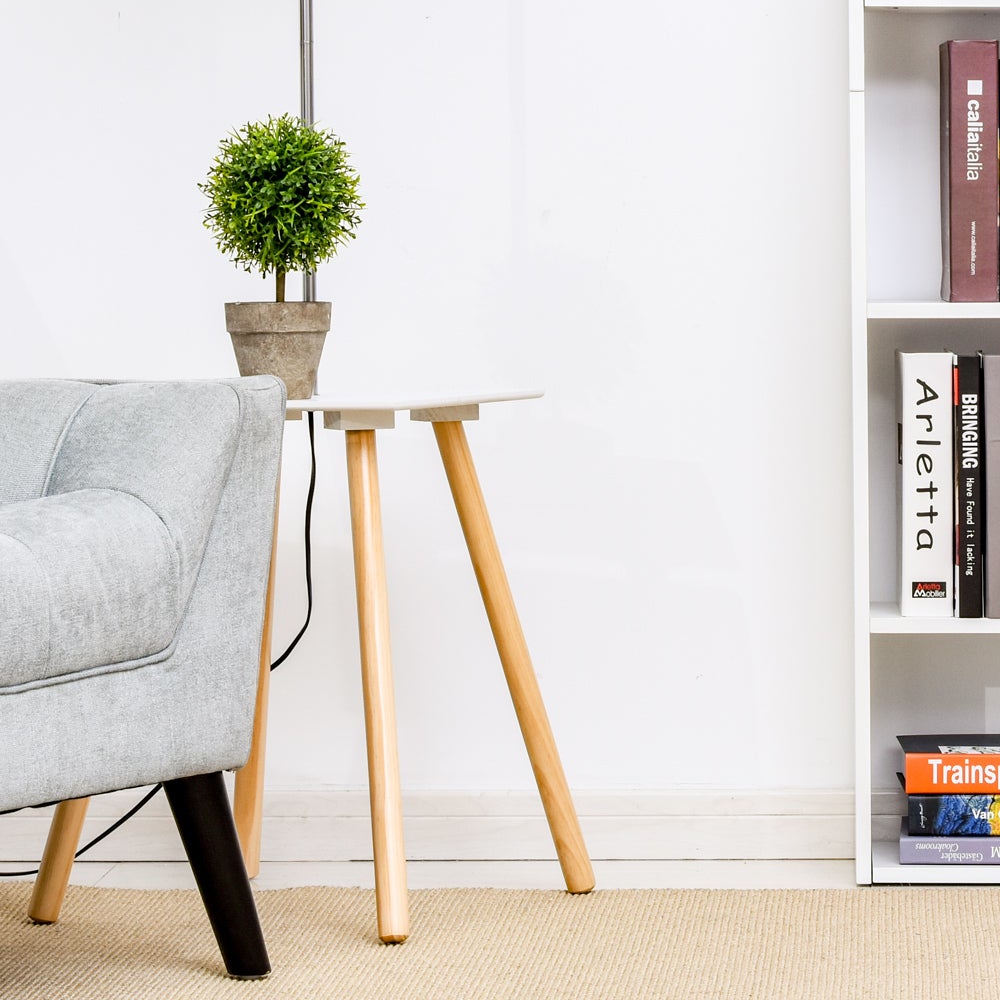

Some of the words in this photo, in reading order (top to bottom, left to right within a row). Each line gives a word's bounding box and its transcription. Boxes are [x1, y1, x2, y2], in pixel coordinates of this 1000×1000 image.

[966, 99, 984, 181] caliaitalia
[961, 393, 978, 469] BRINGING
[915, 378, 942, 551] Arletta
[966, 477, 975, 497] Have
[966, 501, 975, 525] Found
[966, 529, 975, 539] it
[971, 808, 995, 820] Van
[915, 842, 959, 852] Cloakrooms
[940, 851, 984, 862] Gästebäder
